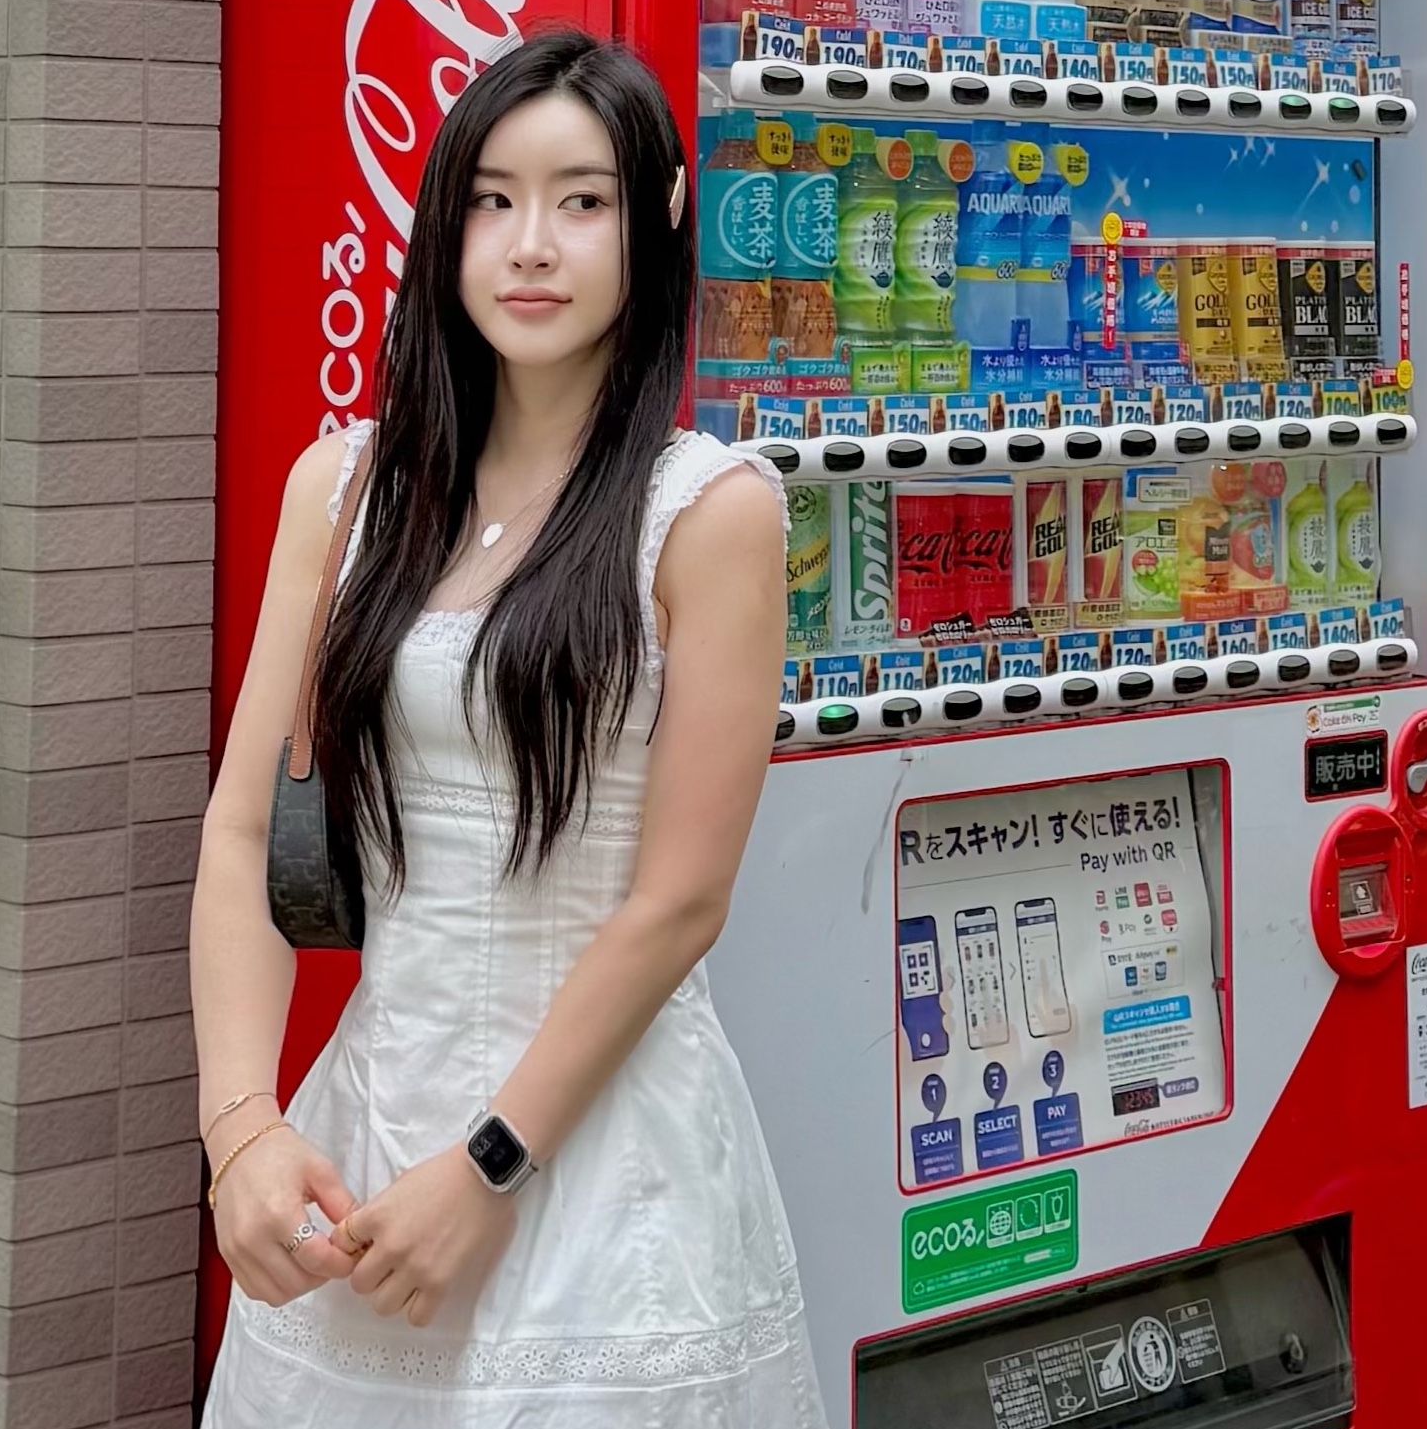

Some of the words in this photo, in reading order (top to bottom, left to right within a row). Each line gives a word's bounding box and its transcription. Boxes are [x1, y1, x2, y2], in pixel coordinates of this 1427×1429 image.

[745, 181, 776, 260] 麦茶
[809, 182, 838, 260] 麦茶
[1048, 795, 1181, 844] すぐに使える!
[1080, 852, 1109, 873] Pay
[1113, 846, 1148, 867] with
[1152, 840, 1176, 863] QR
[1049, 1064, 1058, 1078] 3
[991, 1075, 1000, 1090] 2
[930, 1088, 938, 1102] 1
[1047, 1104, 1068, 1121] PAY
[977, 1114, 1018, 1135] SELECT
[921, 1128, 954, 1147] SCAN
